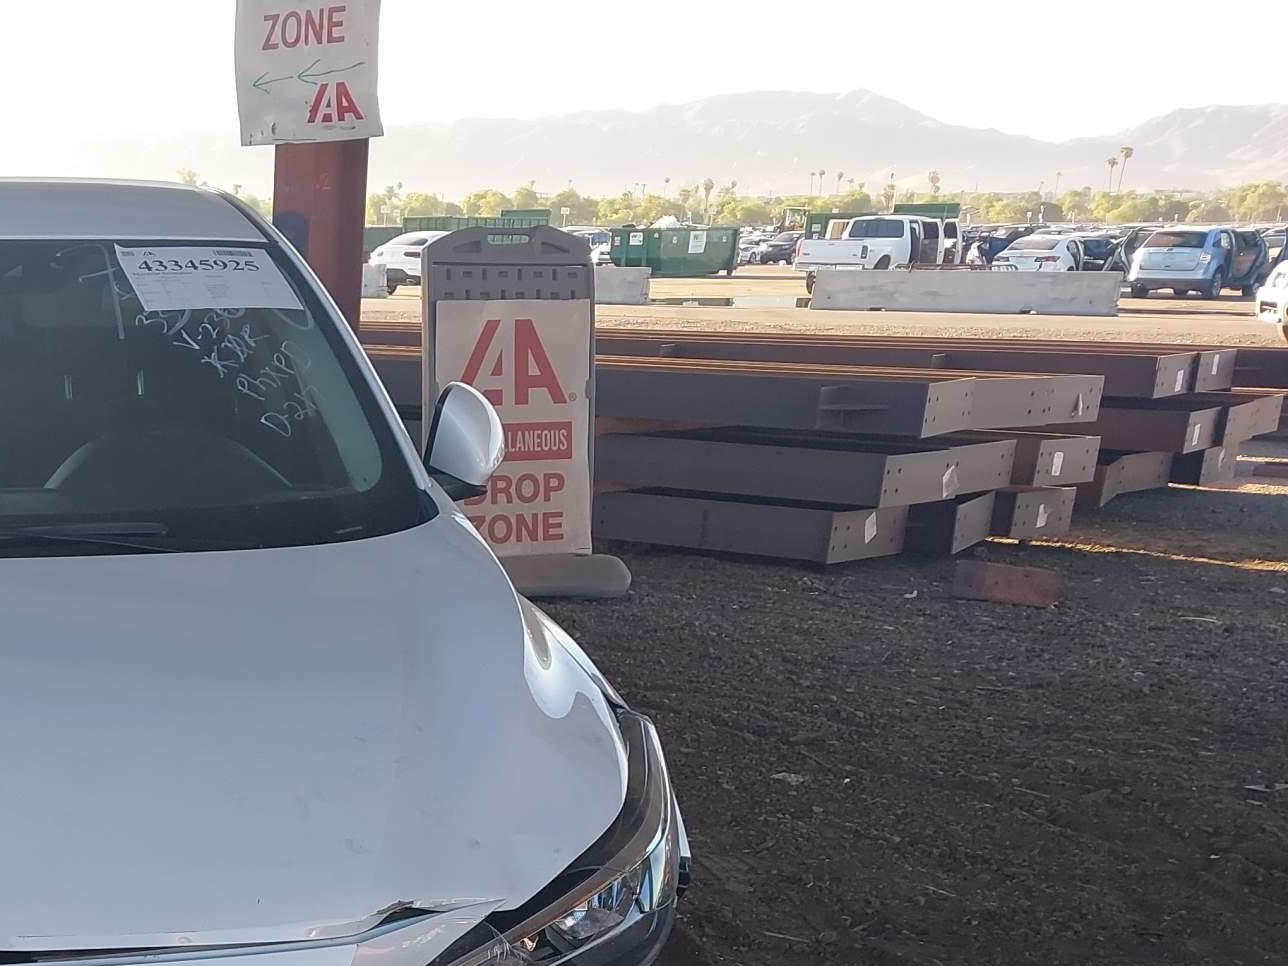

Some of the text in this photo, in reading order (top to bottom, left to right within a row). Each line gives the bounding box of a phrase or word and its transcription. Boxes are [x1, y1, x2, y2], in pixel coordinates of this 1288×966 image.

[262, 5, 346, 51] ZONE
[138, 259, 260, 272] 43345925
[505, 429, 569, 452] LANEOUS
